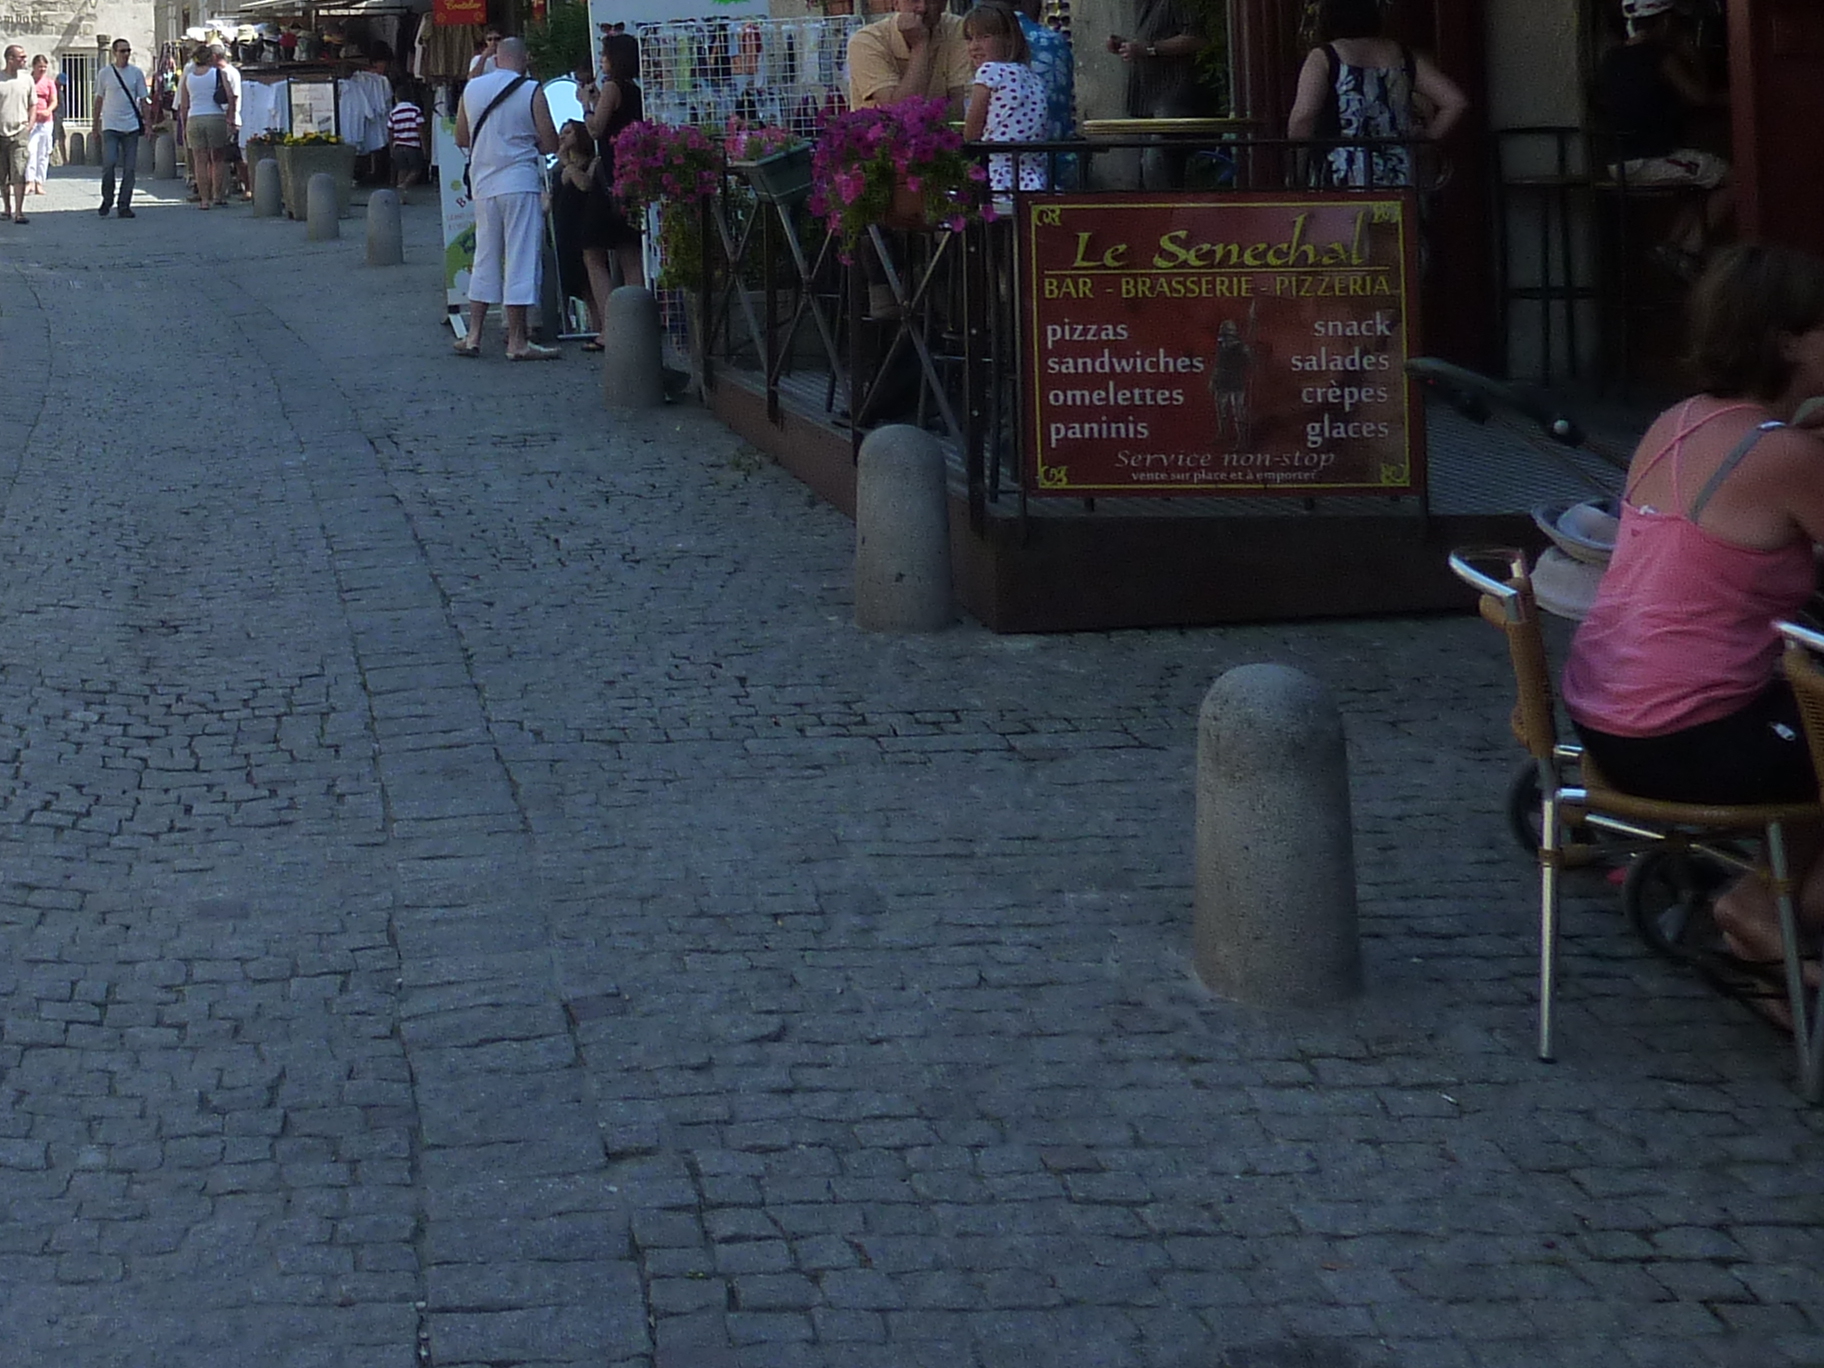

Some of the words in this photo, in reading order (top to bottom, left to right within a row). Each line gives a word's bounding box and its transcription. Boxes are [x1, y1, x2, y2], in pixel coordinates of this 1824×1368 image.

[1072, 231, 1128, 269] Le
[1152, 209, 1367, 270] Senechal
[1044, 278, 1094, 299] BAR
[1120, 277, 1254, 298] BRASSERIE
[1275, 275, 1391, 297] PIZZERIA
[1046, 318, 1129, 348] pizzas
[1312, 310, 1392, 337] snack
[1047, 347, 1205, 374] sandwiches
[1290, 346, 1390, 372] salades
[1048, 381, 1184, 406] omelettes
[1050, 415, 1149, 447] paninis
[1305, 412, 1389, 448] glaces
[1114, 450, 1211, 468] Service
[1222, 450, 1335, 471] non-stop
[1131, 472, 1169, 482] vente
[1170, 473, 1191, 482] sur
[1192, 470, 1228, 483] place
[1229, 472, 1243, 481] et
